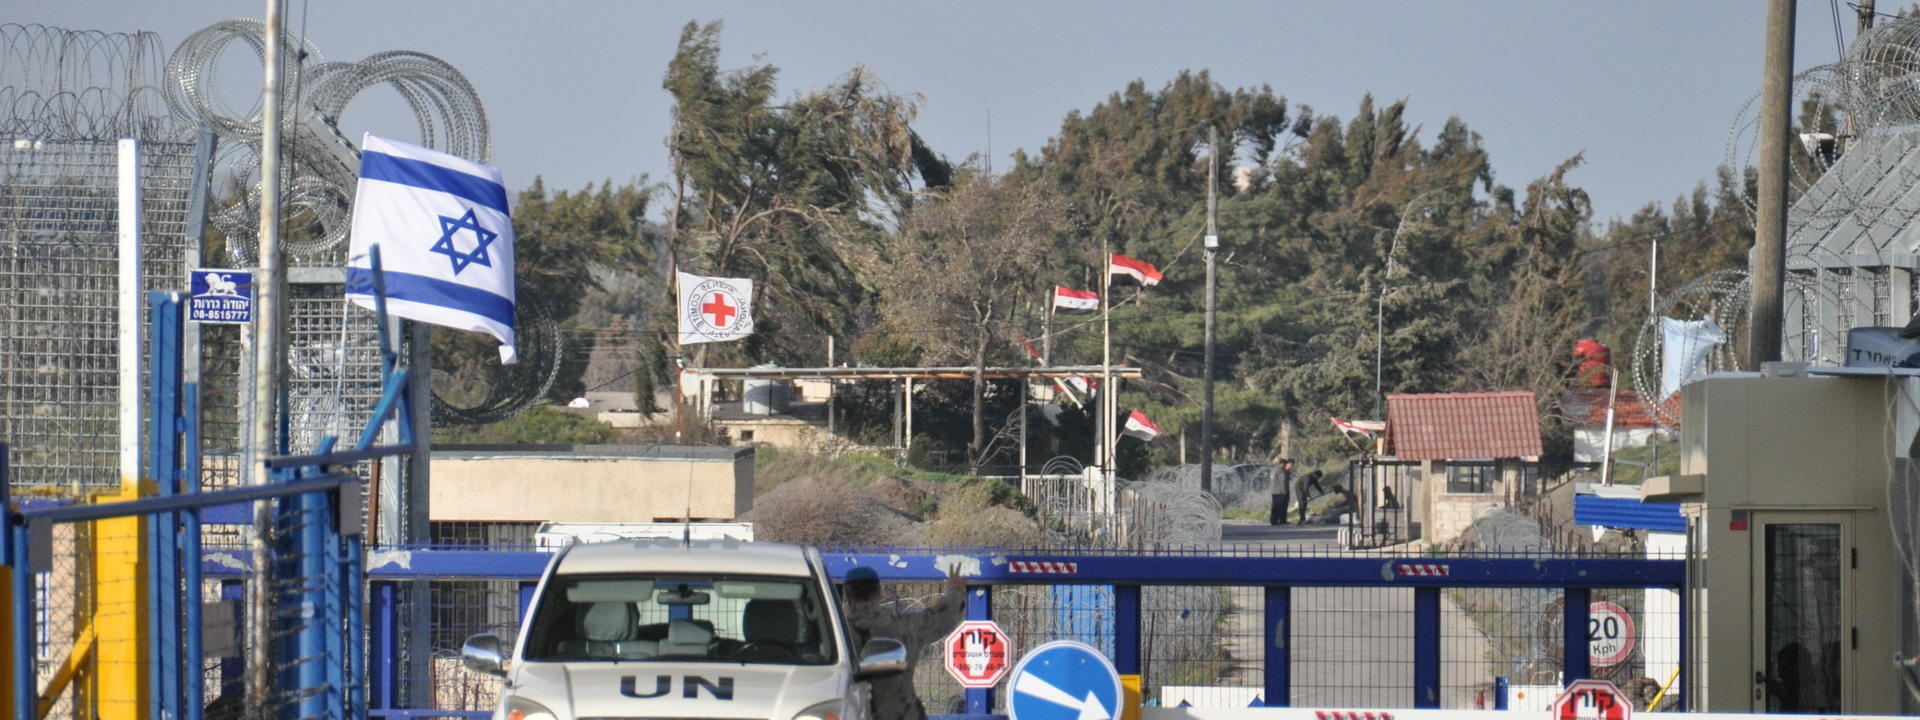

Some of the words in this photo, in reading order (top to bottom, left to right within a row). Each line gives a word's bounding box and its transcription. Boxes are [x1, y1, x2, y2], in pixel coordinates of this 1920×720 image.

[193, 310, 249, 320] 08-8515777
[223, 300, 249, 310] יהודה
[1589, 616, 1619, 641] 20
[960, 629, 997, 649] קורן
[1593, 643, 1616, 655] Kph
[620, 675, 735, 701] UN
[1570, 688, 1616, 713] קורן
